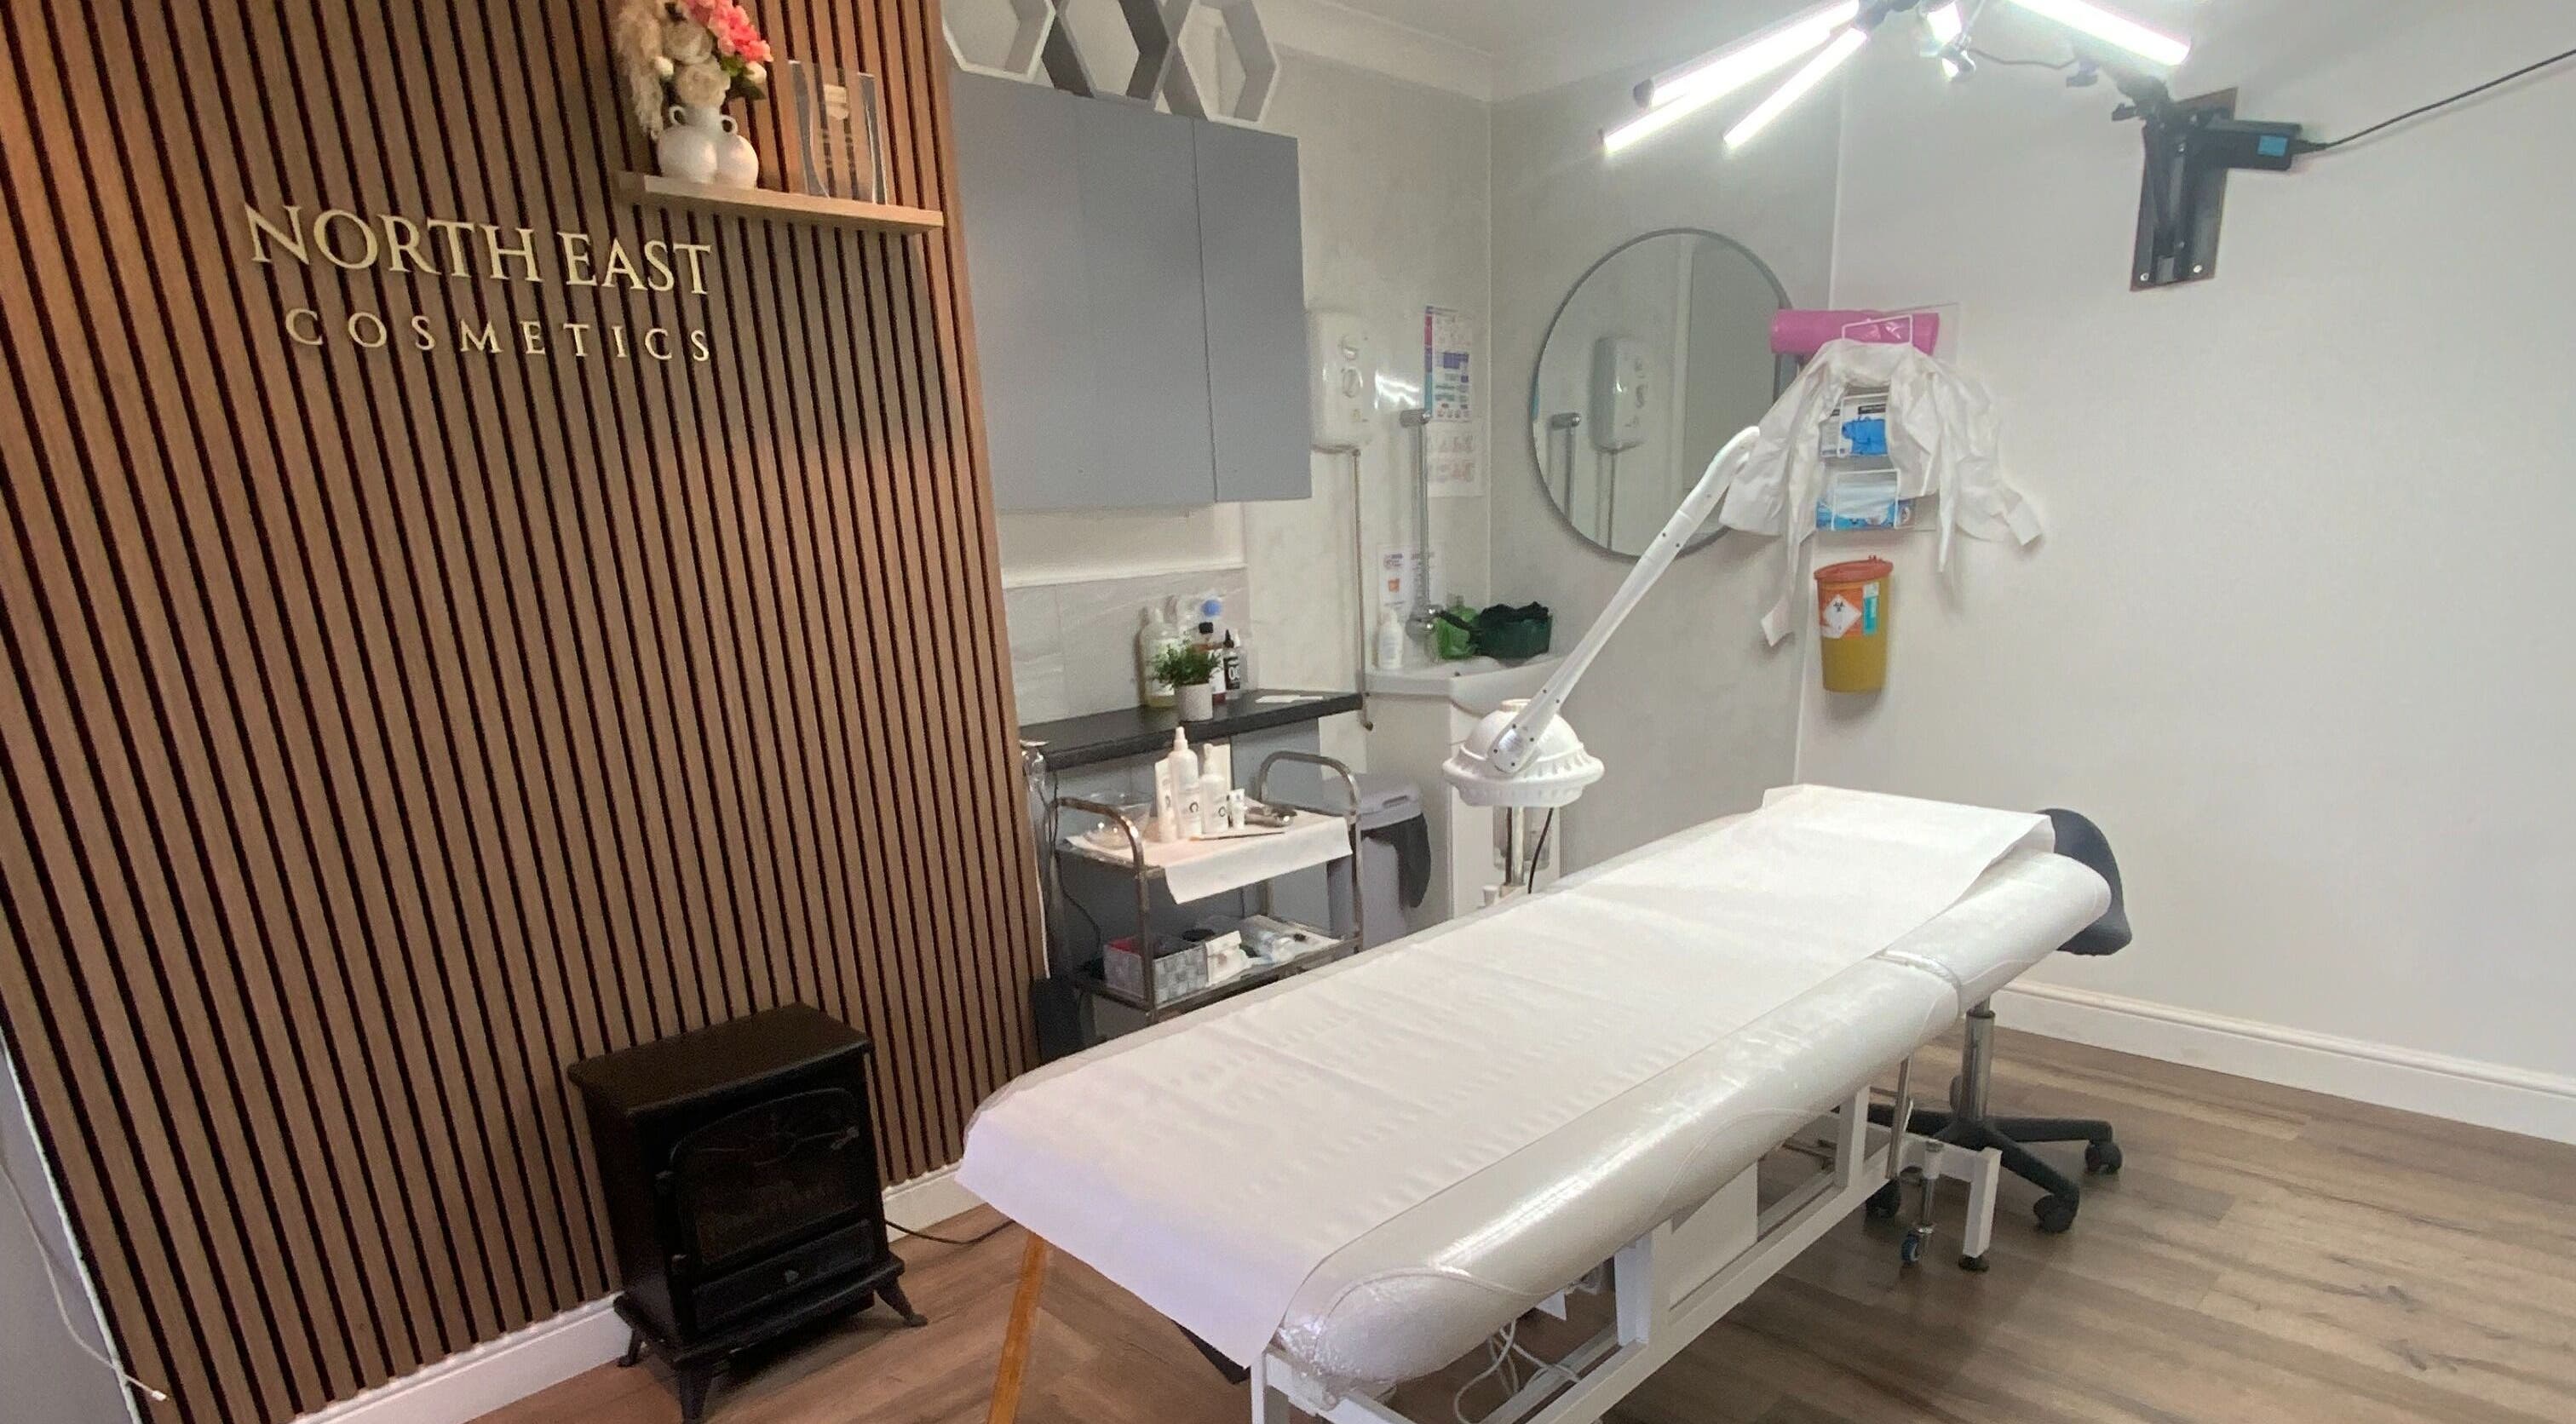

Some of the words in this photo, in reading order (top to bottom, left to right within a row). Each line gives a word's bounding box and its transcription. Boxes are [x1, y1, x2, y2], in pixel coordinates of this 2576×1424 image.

[244, 203, 543, 283] NORTH
[556, 231, 711, 296] EAST
[285, 307, 710, 363] COSMETICS
